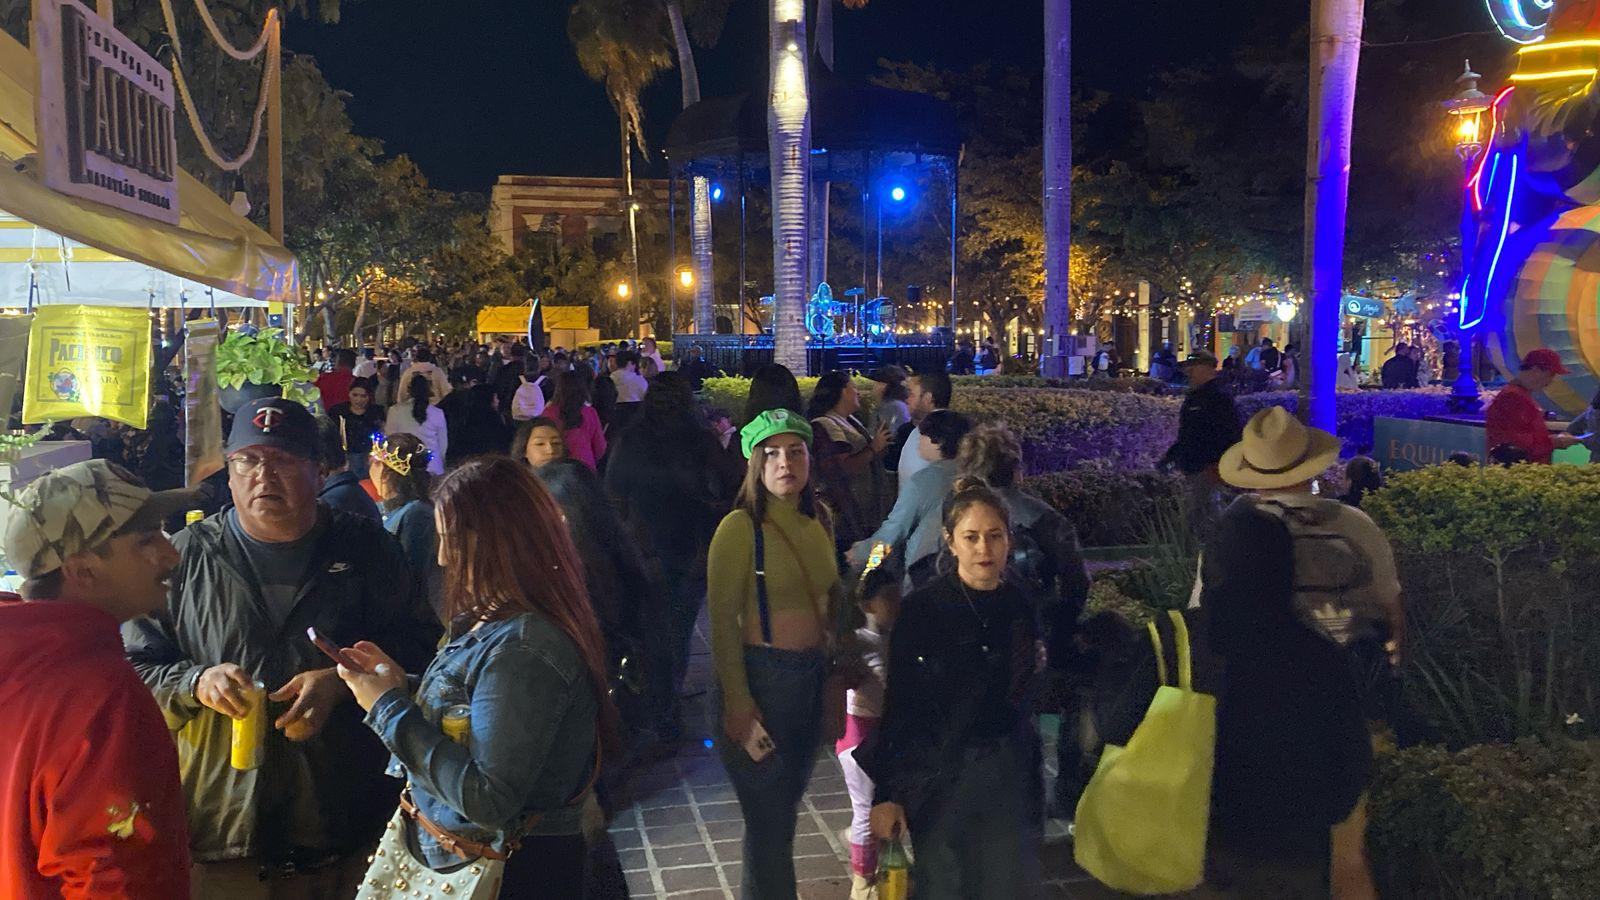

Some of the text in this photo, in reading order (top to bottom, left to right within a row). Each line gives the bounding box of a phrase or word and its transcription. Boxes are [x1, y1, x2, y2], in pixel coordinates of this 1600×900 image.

[146, 69, 164, 91] DEL
[49, 338, 122, 367] PACIICO
[85, 376, 119, 384] CARA
